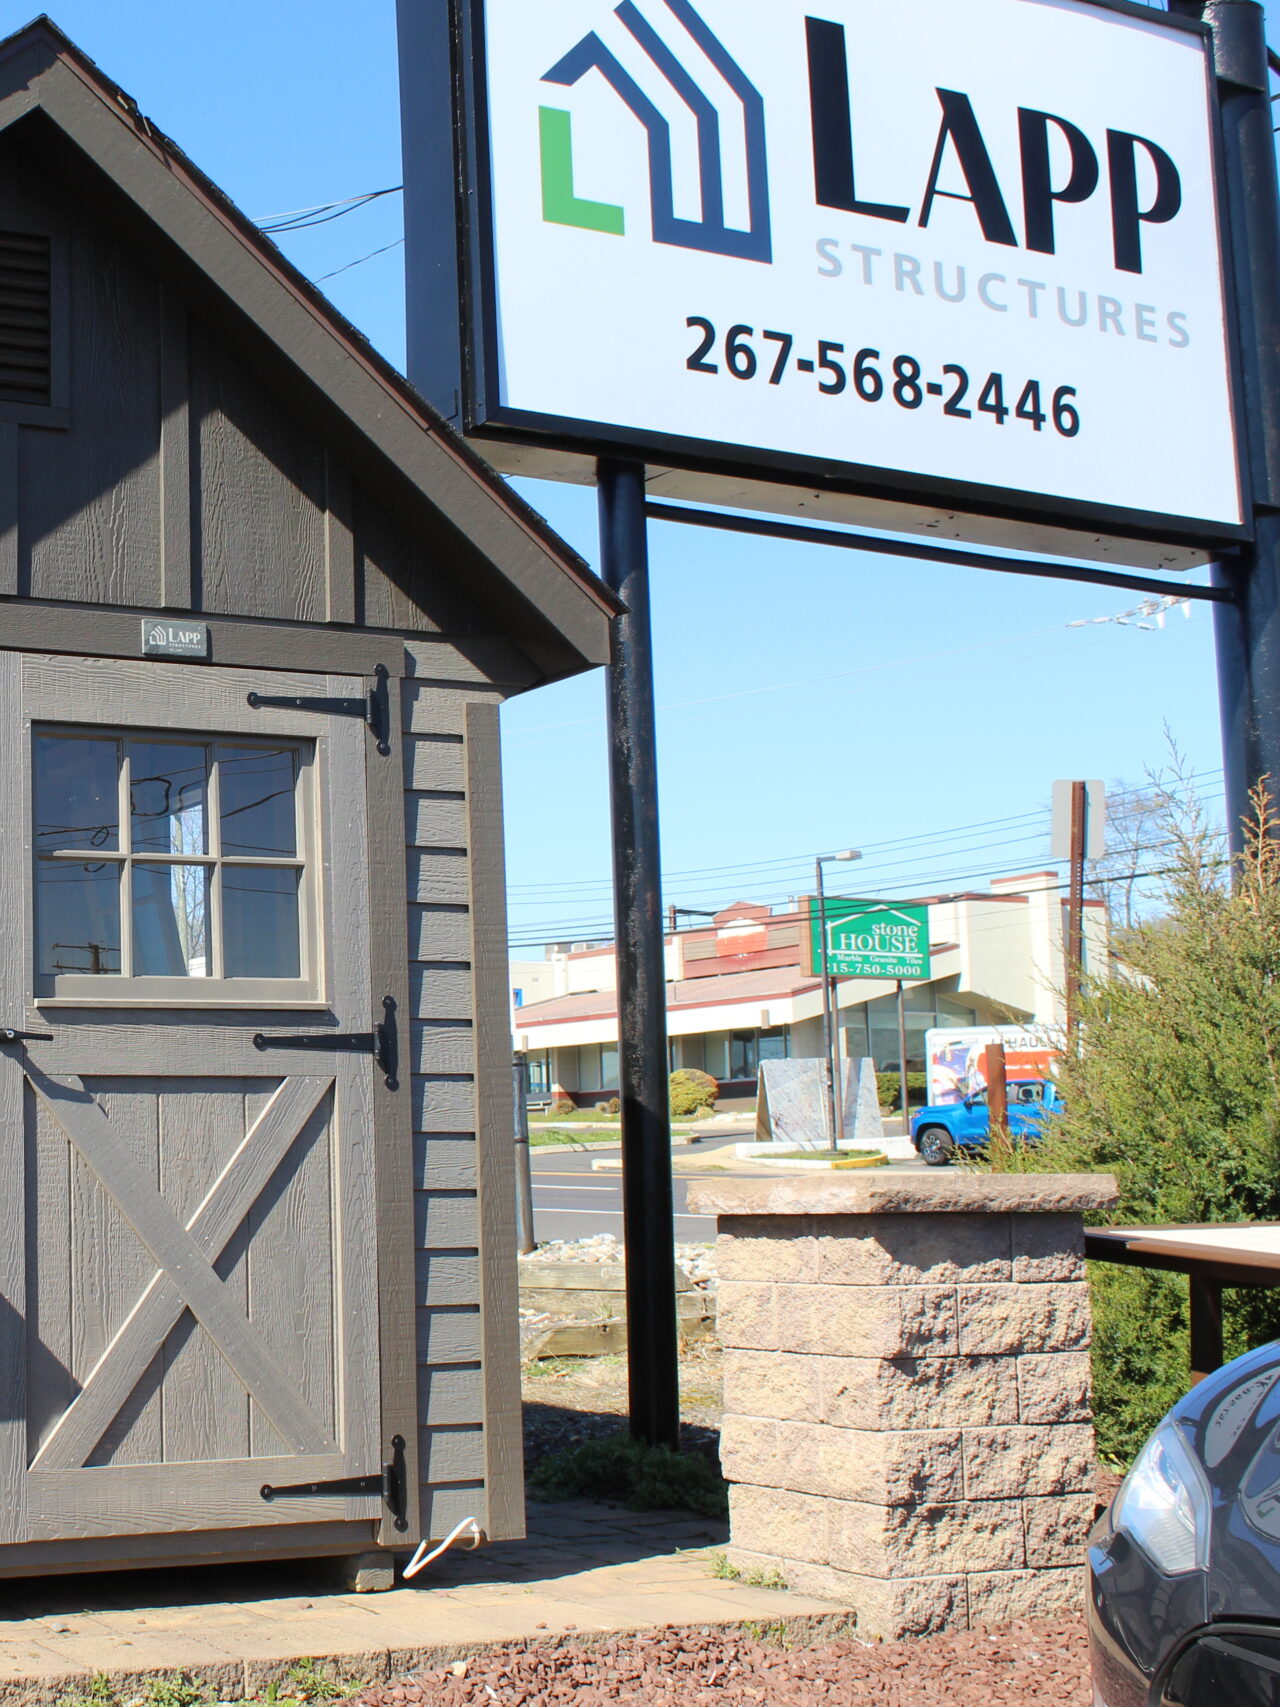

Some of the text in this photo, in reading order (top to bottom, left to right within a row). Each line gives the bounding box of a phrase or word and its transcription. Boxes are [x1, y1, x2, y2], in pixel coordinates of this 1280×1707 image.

[805, 16, 1181, 274] LAPP
[815, 237, 1190, 349] STRUCTURES
[686, 316, 1080, 438] 267-568-2446
[168, 627, 201, 644] LAPP
[871, 922, 919, 936] stone
[840, 933, 918, 953] HOUSE
[836, 953, 923, 965] Marble Granite Tiles
